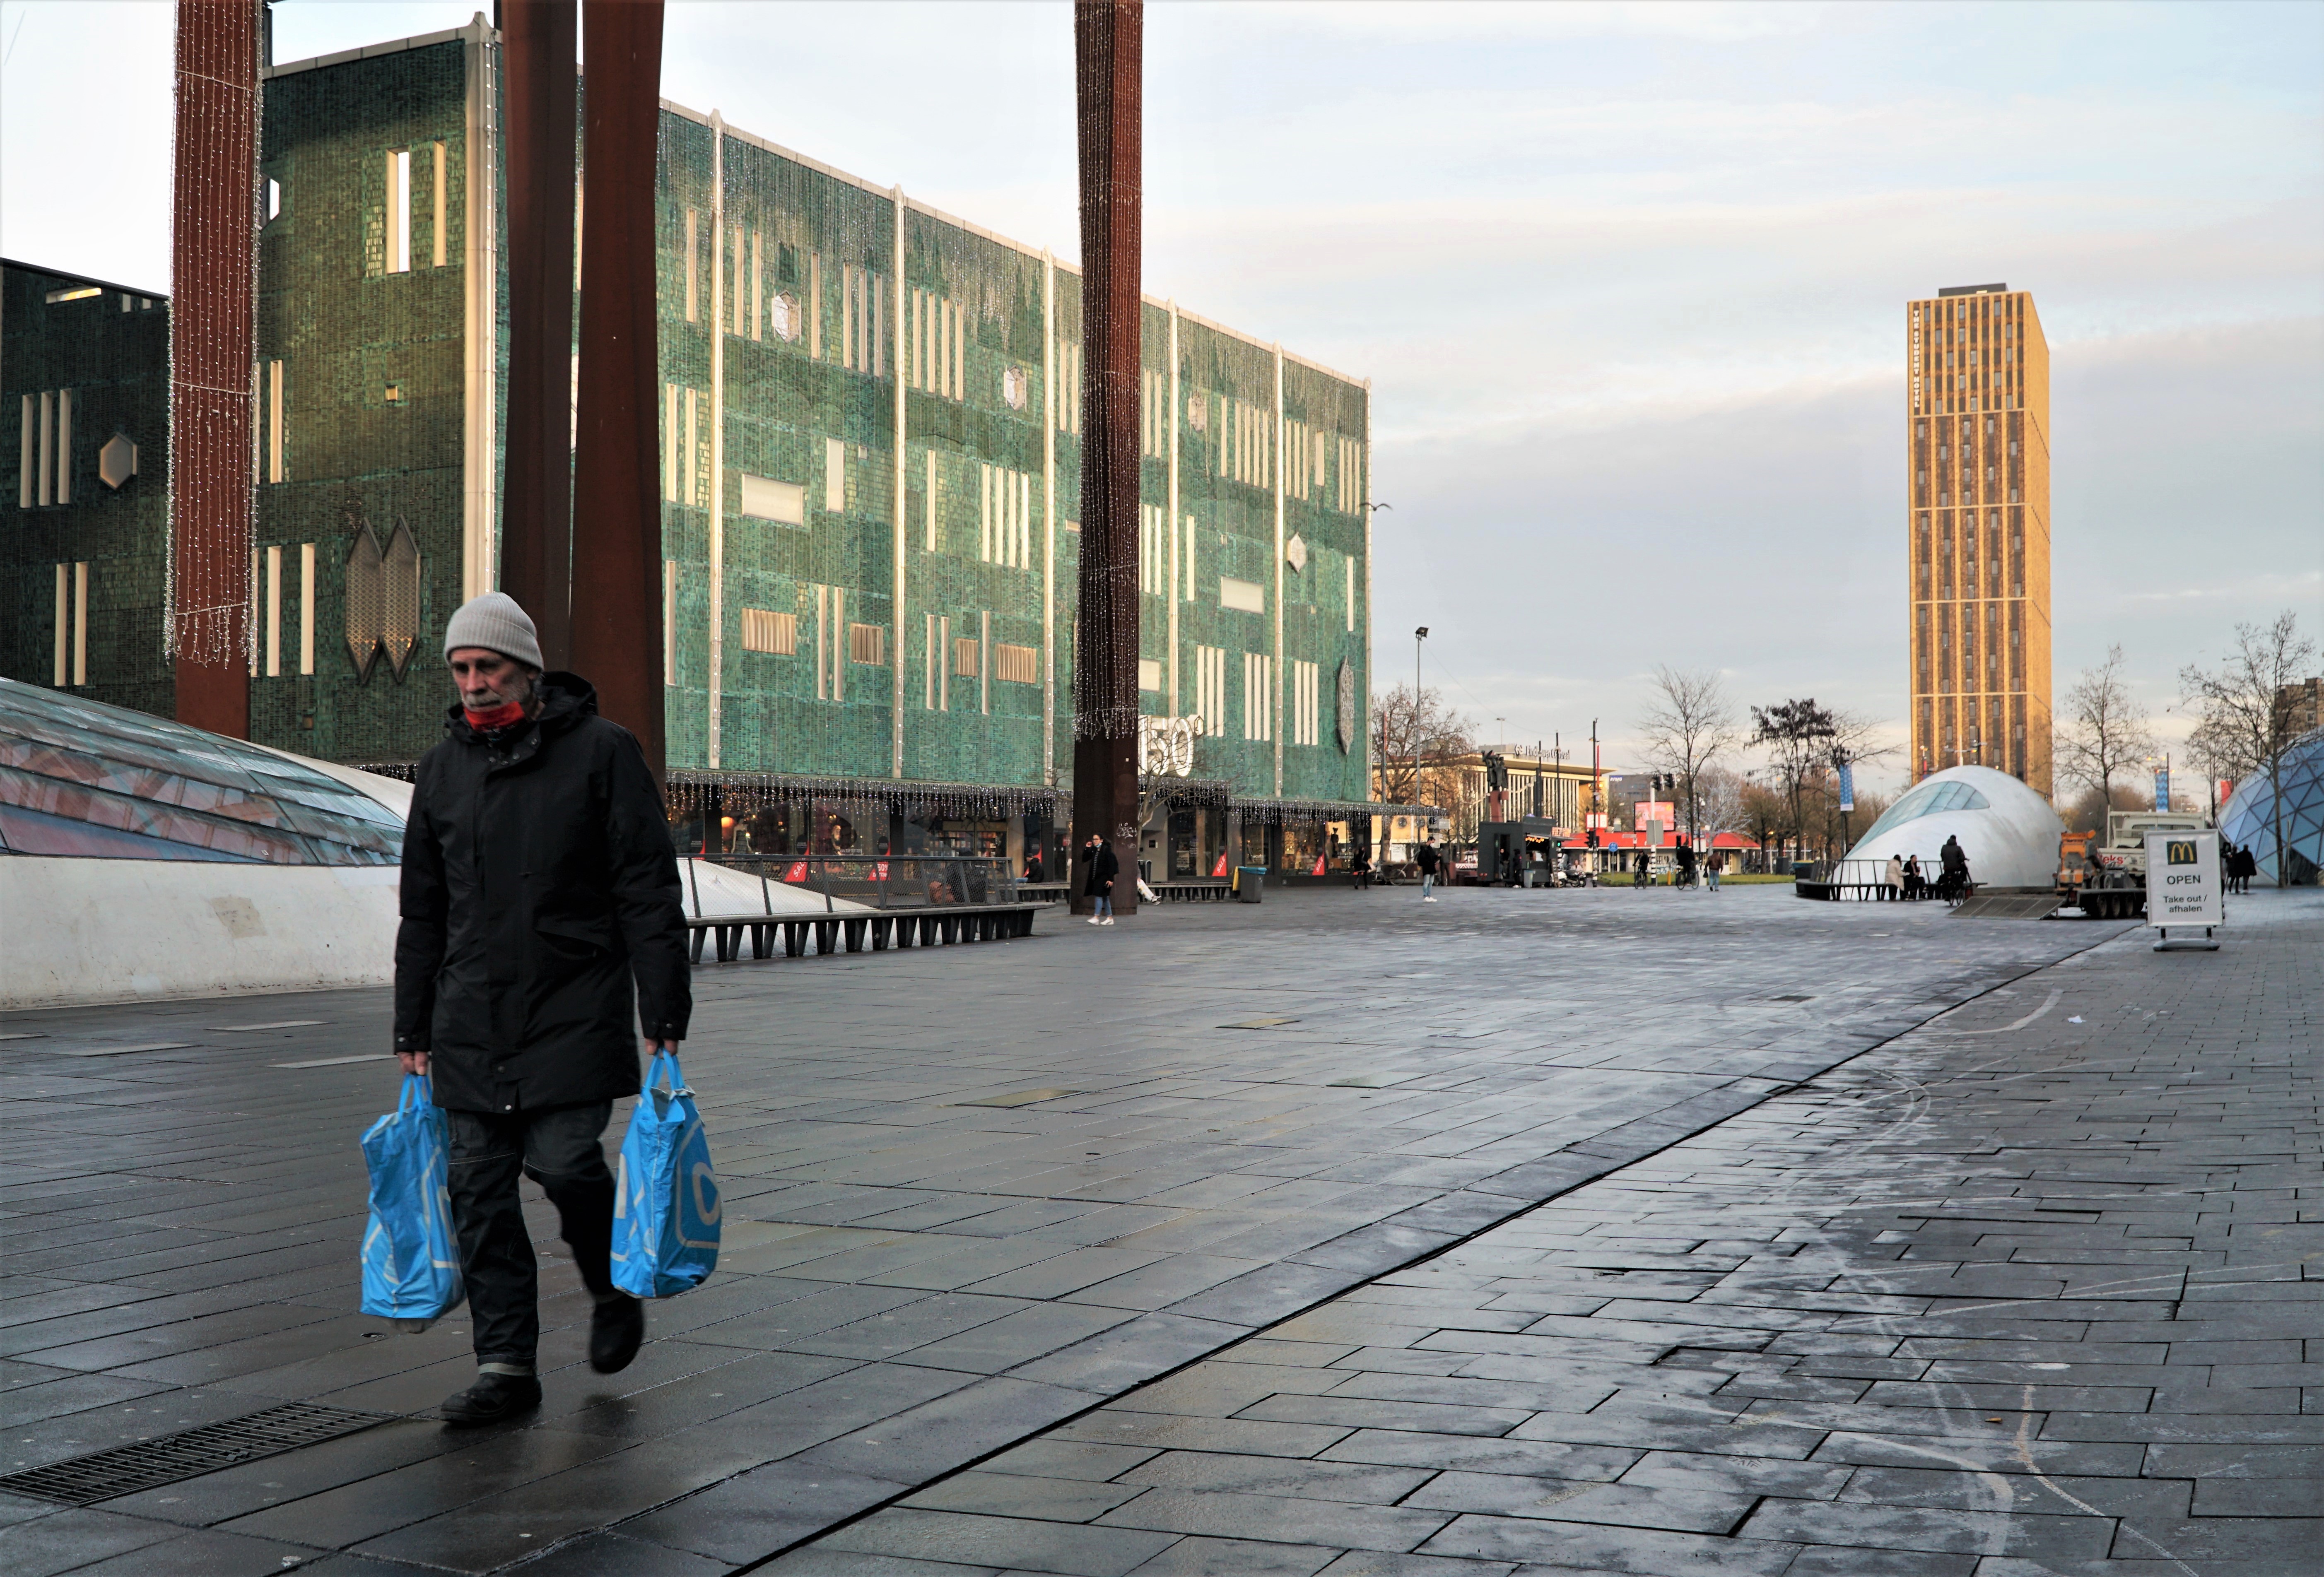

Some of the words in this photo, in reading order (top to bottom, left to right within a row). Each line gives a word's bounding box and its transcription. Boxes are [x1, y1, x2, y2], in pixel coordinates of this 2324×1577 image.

[793, 861, 806, 878] SAL
[1217, 856, 1226, 873] SALE
[2167, 875, 2201, 884] OPEN
